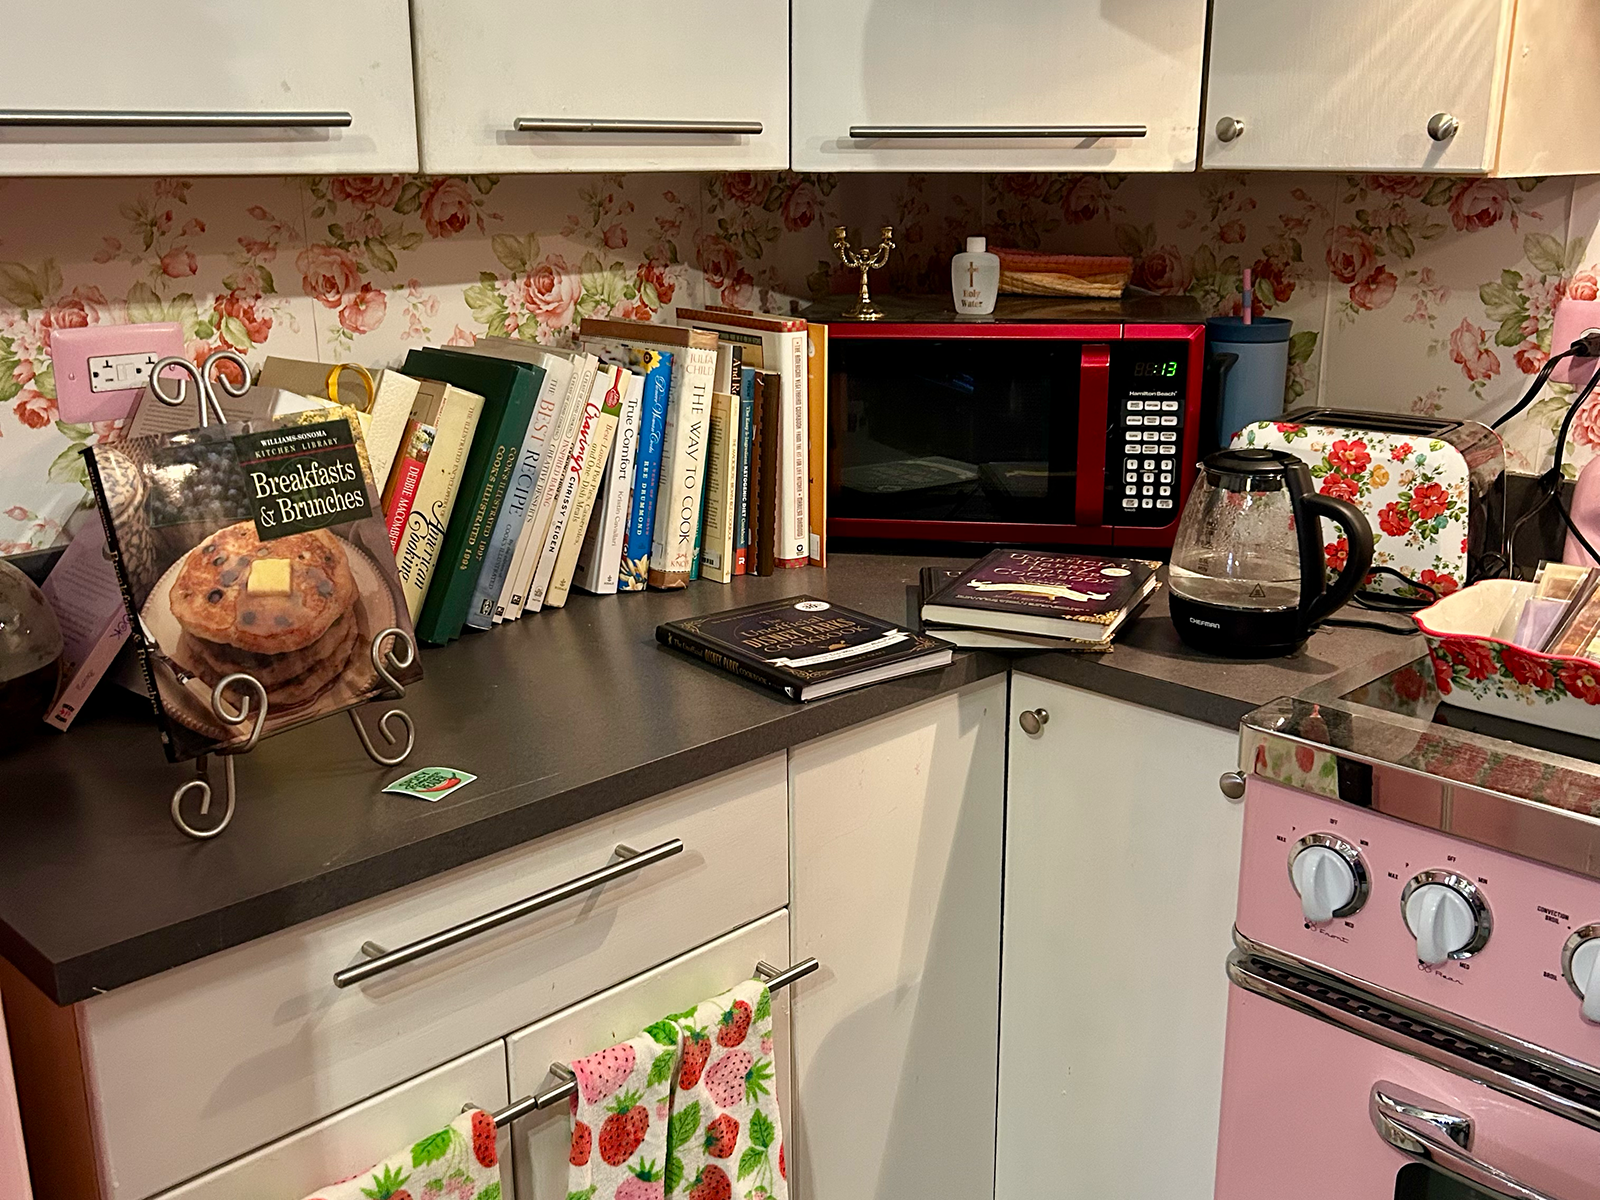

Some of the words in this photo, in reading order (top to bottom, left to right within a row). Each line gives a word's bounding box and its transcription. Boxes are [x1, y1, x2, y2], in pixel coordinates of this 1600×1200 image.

[961, 300, 983, 308] Water
[963, 290, 981, 299] Holy
[685, 364, 714, 376] CHILD
[690, 353, 714, 364] JULIA
[730, 357, 743, 381] And
[546, 377, 558, 396] THE
[650, 374, 668, 404] Pioneer
[690, 382, 706, 415] THE
[466, 406, 475, 419] THE
[528, 398, 556, 447] BEST
[624, 397, 639, 426] True
[647, 401, 665, 433] Woman
[254, 444, 296, 459] KITCHEN
[301, 437, 338, 451] LIBRARY
[260, 429, 327, 447] WILLIAMS-SONOMA
[453, 420, 471, 463] ILLUSTRATED
[570, 401, 600, 484] Cravings
[587, 442, 600, 459] and
[594, 423, 613, 469] Best-Loved
[684, 419, 702, 461] WAY
[487, 444, 506, 483] COOK'S
[500, 446, 517, 480] COOK'S
[537, 443, 556, 484] CREATIVE
[551, 438, 571, 477] INSPIRED
[616, 427, 635, 481] Comfort
[250, 459, 356, 499] Breakfasts
[400, 465, 420, 497] DEBBIE
[576, 458, 596, 499] One-Dish
[590, 468, 600, 483] Pot
[641, 460, 649, 478] REE
[683, 464, 697, 489] TO
[506, 448, 541, 518] RECIPE
[541, 476, 558, 508] BAKING
[558, 475, 576, 516] CHRISSY
[584, 483, 596, 503] Pies,
[648, 488, 654, 498] OF
[260, 506, 277, 528] &
[276, 487, 365, 524] Brunches
[467, 482, 494, 546] ILLUSTRATED
[481, 480, 506, 538] ILLUSTRATED
[524, 483, 543, 524] DESSERTS
[570, 498, 585, 523] Meals
[614, 489, 624, 515] Kristin
[635, 482, 647, 535] DRUMMOND
[572, 502, 591, 546] Casseroles,
[677, 494, 694, 546] COOK
[398, 510, 430, 584] Cooking
[415, 500, 446, 590] American
[547, 519, 563, 553] TEIGEN
[474, 539, 487, 561] 1997
[1010, 553, 1129, 569] UNOFFICIAL
[487, 546, 505, 590] ILLUSTRATED
[993, 567, 1115, 585] COOKBOOK
[1018, 559, 1097, 575] HARRY
[1028, 566, 1101, 578] POTTER
[740, 615, 825, 638] Unofficial
[742, 628, 800, 649] DISNEY
[801, 618, 856, 635] PARKS
[1189, 617, 1221, 629] CHEFMAN
[764, 625, 870, 653] COOKBOOK
[671, 638, 683, 647] The
[701, 648, 723, 666] DISNEY
[737, 666, 769, 685] COOKBOOK
[1276, 835, 1287, 843] MAX
[1360, 839, 1369, 847] MIN
[1447, 855, 1456, 863] OFF
[1387, 872, 1399, 880] MAX
[1478, 877, 1488, 885] MIN
[1344, 920, 1355, 929] MED
[1537, 905, 1569, 921] CONVECTION
[1545, 915, 1560, 925] BROIL
[1319, 928, 1350, 944] Front
[1435, 970, 1464, 986] Rear
[1459, 962, 1470, 970] MED
[1543, 971, 1558, 981] BROIL
